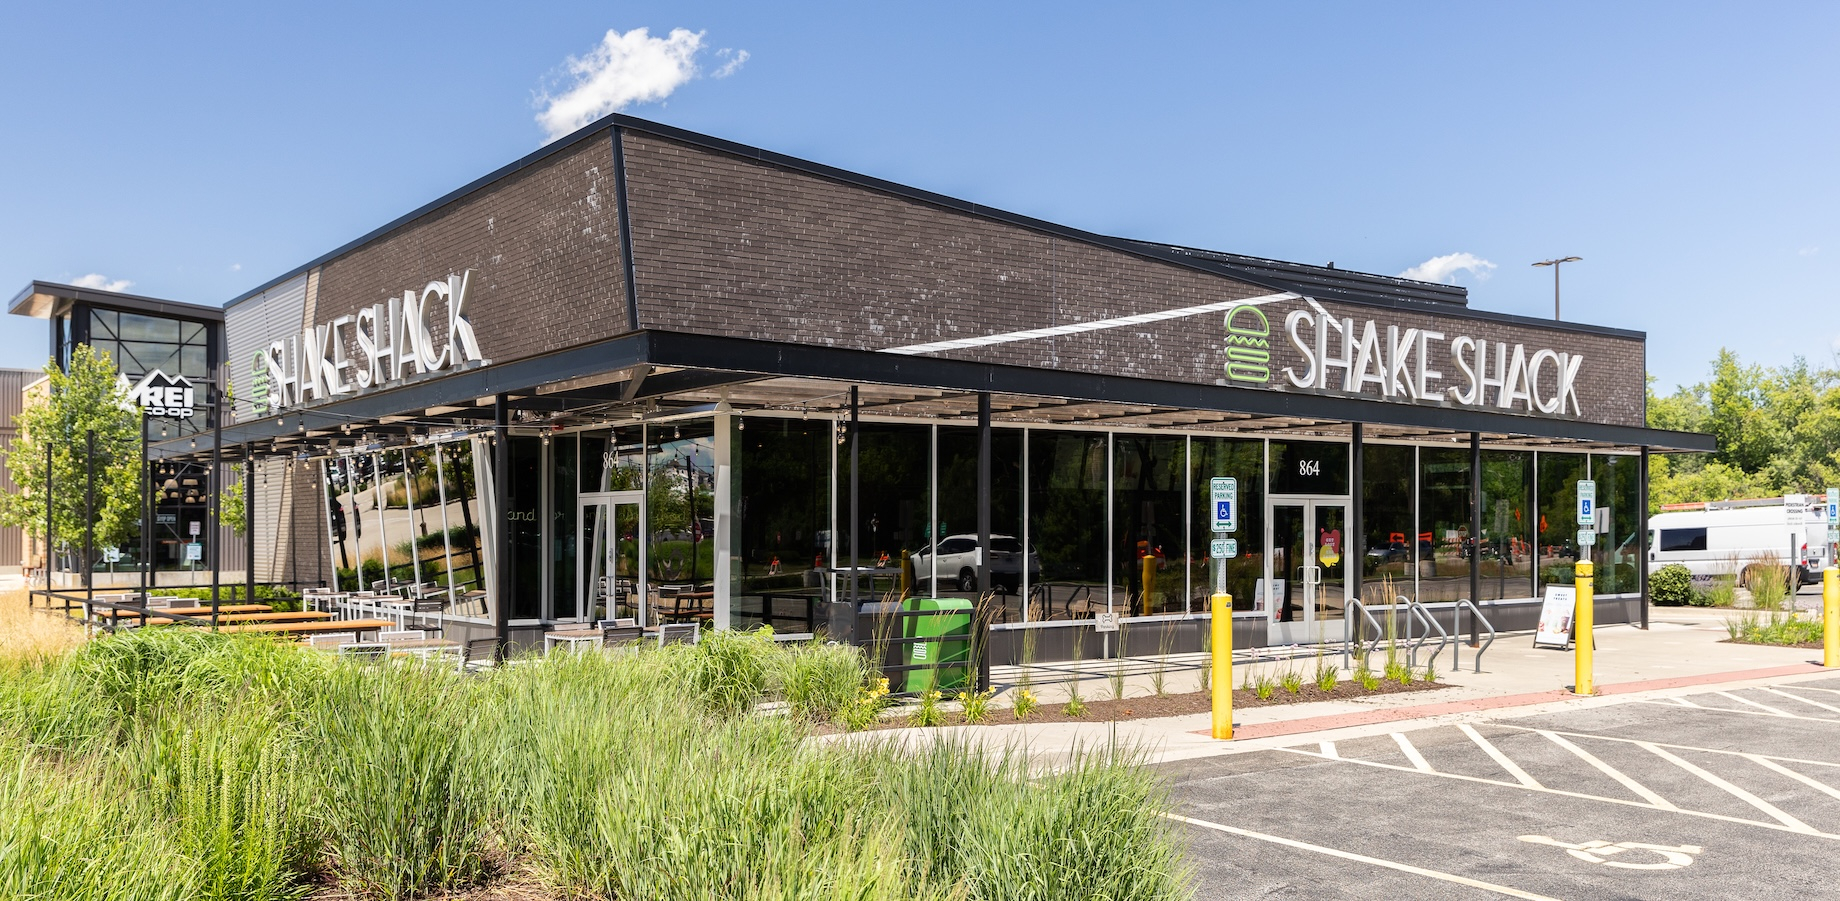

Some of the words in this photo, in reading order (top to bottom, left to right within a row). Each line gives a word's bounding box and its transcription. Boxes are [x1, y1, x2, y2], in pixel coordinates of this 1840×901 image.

[268, 314, 357, 408] SHAKE
[356, 268, 483, 389] SHACK
[1281, 310, 1445, 401] SHAKE
[1448, 336, 1583, 417] SHACK
[140, 386, 194, 408] REI
[603, 451, 619, 469] 864
[1299, 460, 1320, 476] 864
